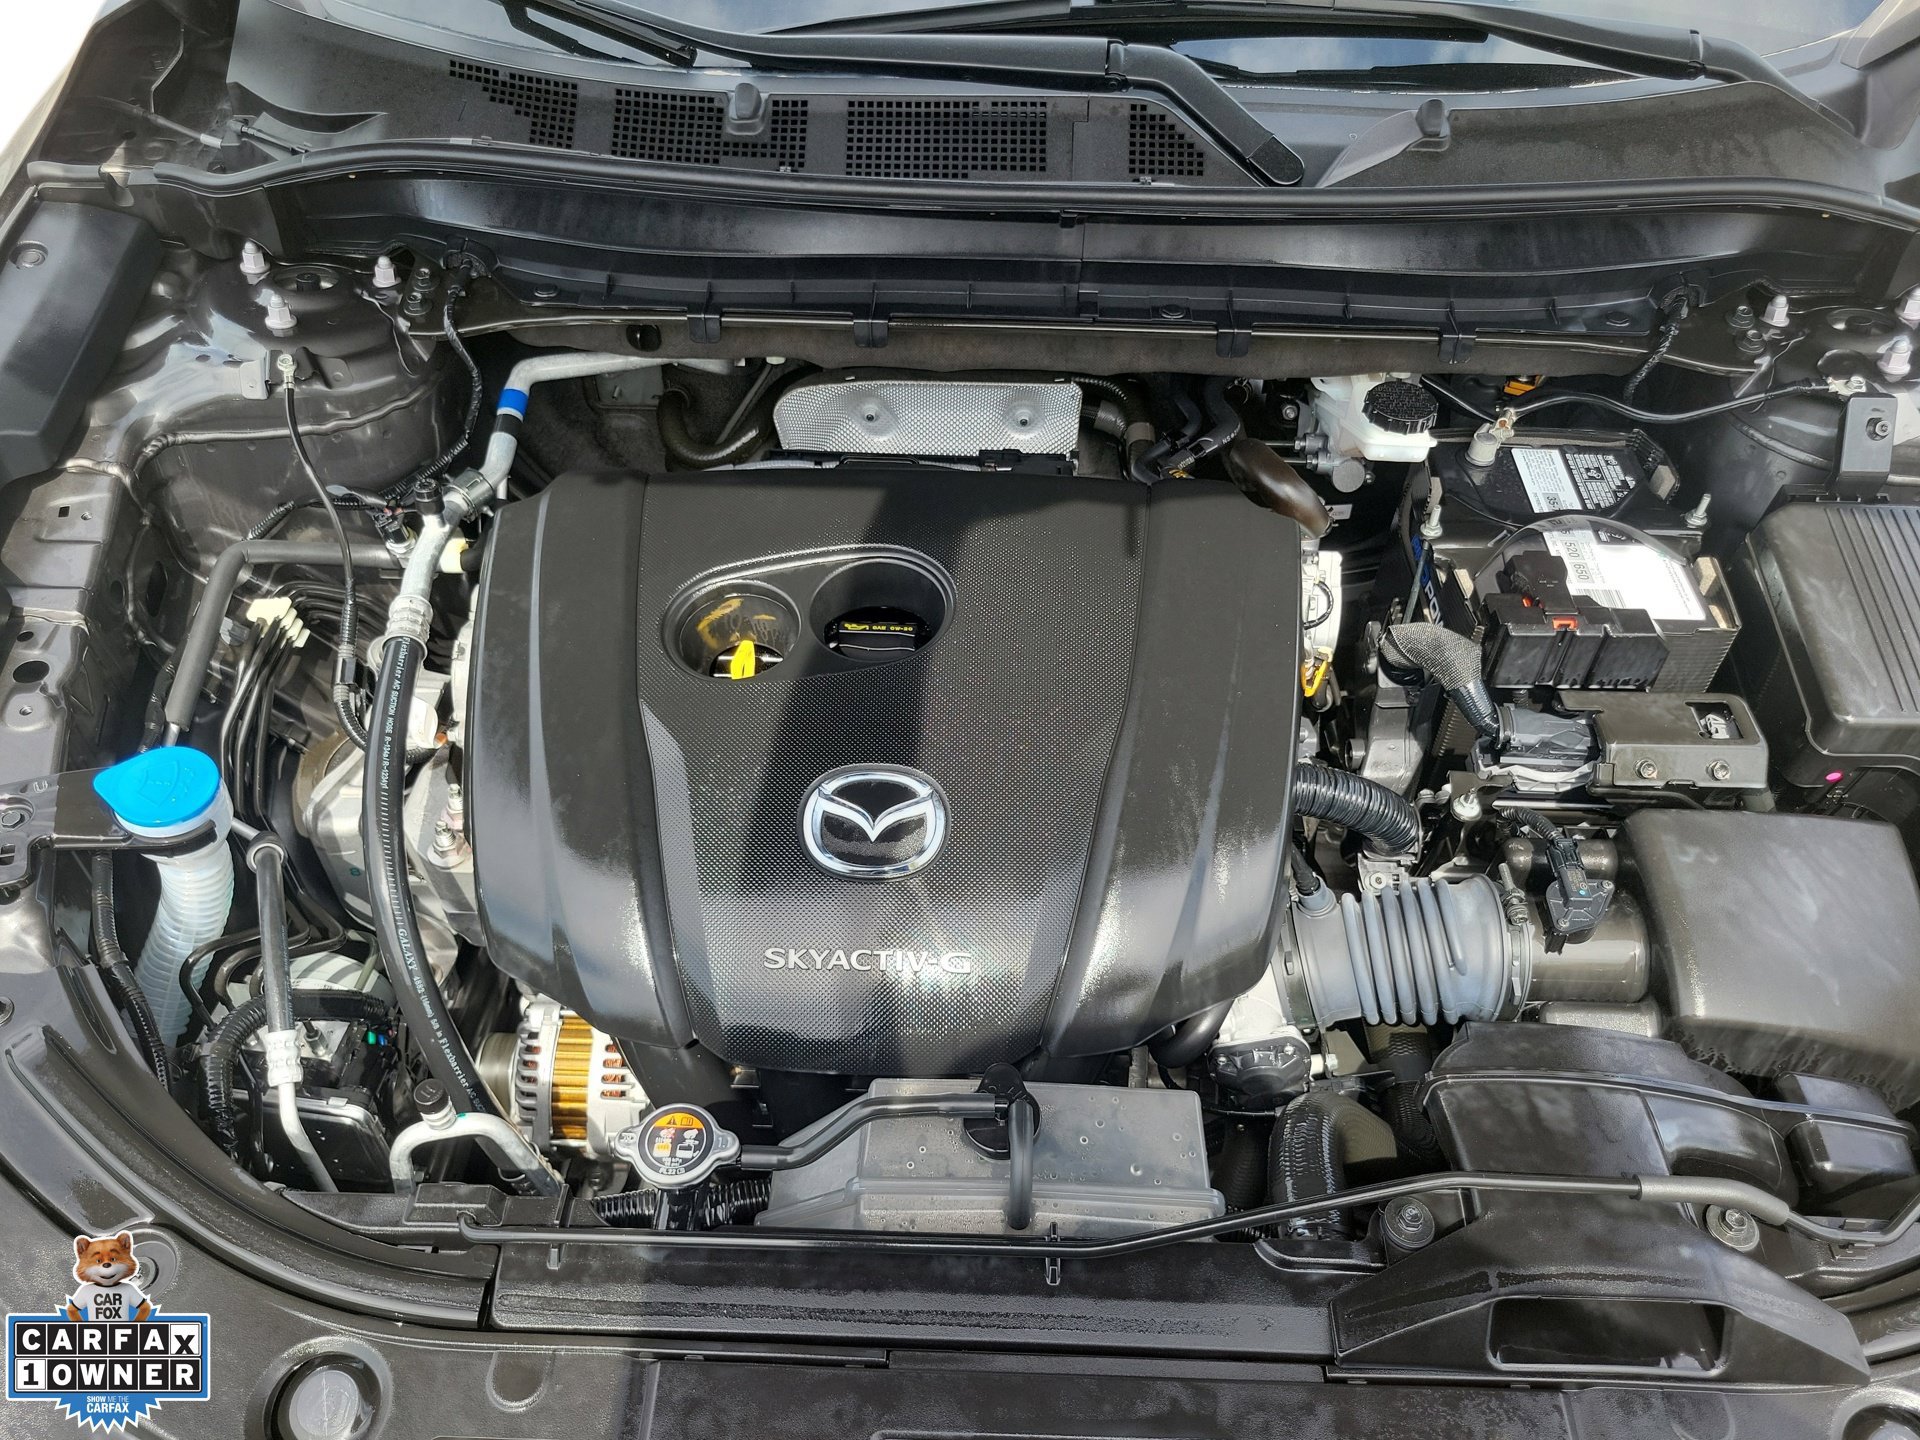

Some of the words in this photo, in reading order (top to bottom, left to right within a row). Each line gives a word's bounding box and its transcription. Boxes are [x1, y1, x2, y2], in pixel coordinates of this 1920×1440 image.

[1564, 541, 1580, 558] 520
[1573, 563, 1590, 581] 650
[394, 636, 411, 679] Flexbarrier
[388, 690, 399, 716] SUCTION
[385, 716, 395, 734] HOSE
[763, 947, 972, 974] SKYACTIV-G
[398, 928, 418, 971] GALAXY
[438, 1037, 470, 1088] Flexbarrier
